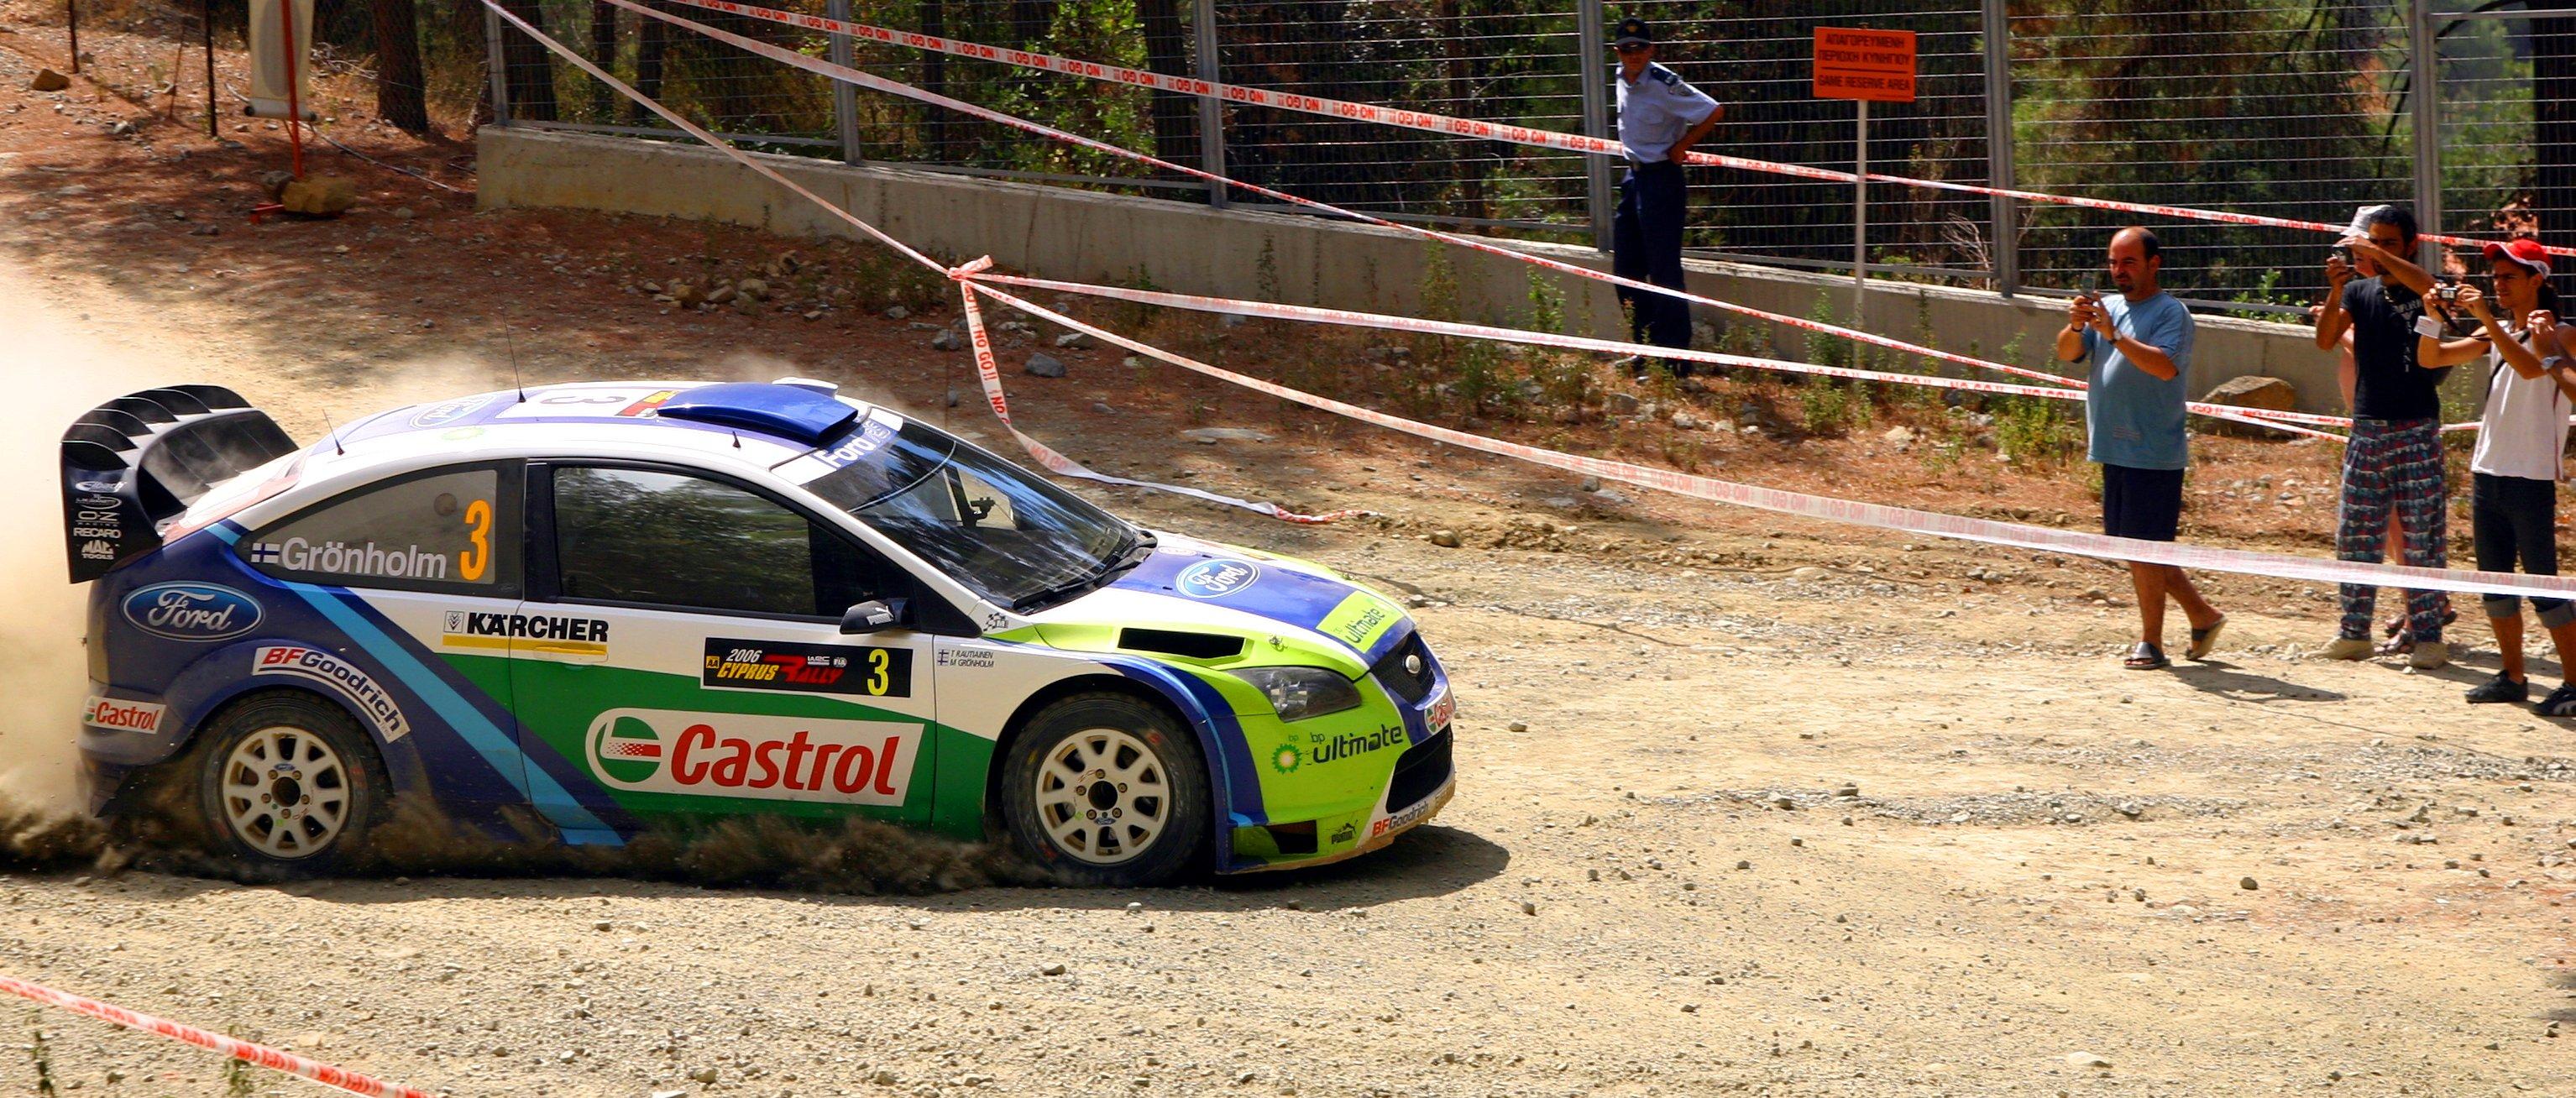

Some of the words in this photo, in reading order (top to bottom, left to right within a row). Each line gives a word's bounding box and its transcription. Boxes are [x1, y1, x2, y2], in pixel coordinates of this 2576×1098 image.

[1818, 74, 1842, 87] GAME
[1845, 76, 1884, 90] RESERVE
[1887, 78, 1911, 91] AREA
[973, 329, 987, 348] NO
[978, 351, 994, 370] GO
[991, 396, 1005, 414] NO
[73, 527, 122, 538] RECARO
[459, 499, 491, 581] 3
[281, 536, 447, 579] Grönholm
[1188, 563, 1248, 591] Ford
[148, 589, 235, 631] Ford
[467, 612, 609, 642] KÄRCHER
[726, 649, 762, 662] 2006
[716, 661, 780, 681] CYPRUS
[867, 648, 889, 696] 3
[263, 647, 401, 733] BFGoodrich
[95, 701, 160, 731] Castrol
[1313, 724, 1404, 764] ultimate
[671, 724, 901, 796] Castrol
[1372, 801, 1428, 837] BFGoodrich
